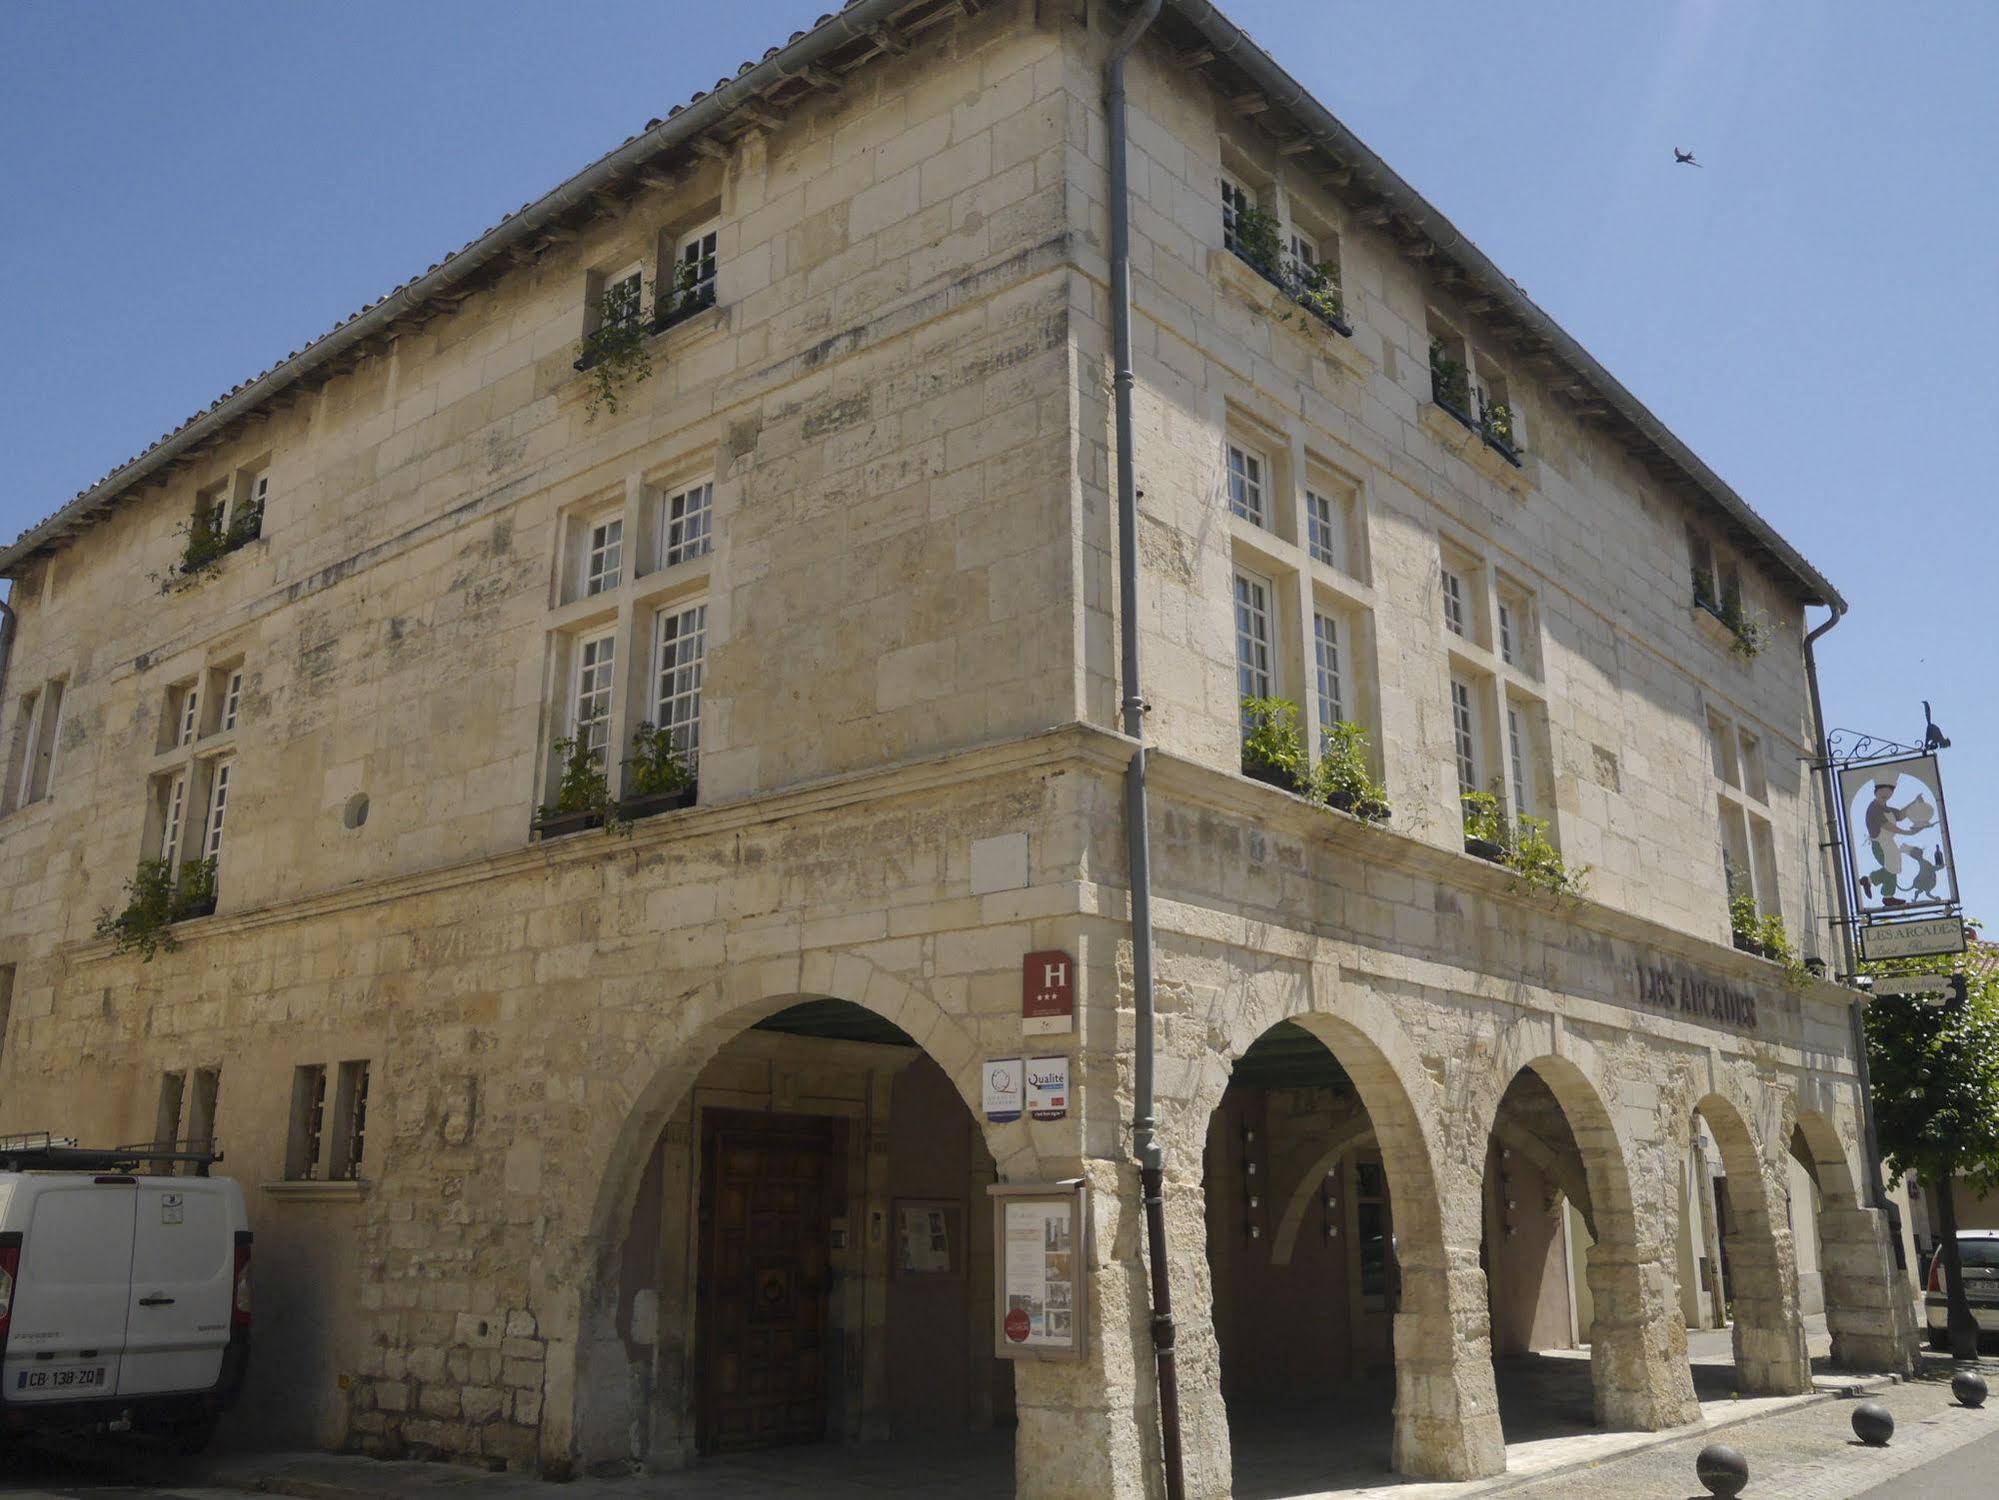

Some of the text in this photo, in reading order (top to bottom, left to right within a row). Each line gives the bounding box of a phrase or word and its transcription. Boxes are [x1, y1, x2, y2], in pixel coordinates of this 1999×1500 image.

[1865, 919, 1960, 940] LES ARCADES
[1044, 963, 1067, 988] H
[1637, 964, 1758, 1028] LES ARCADES
